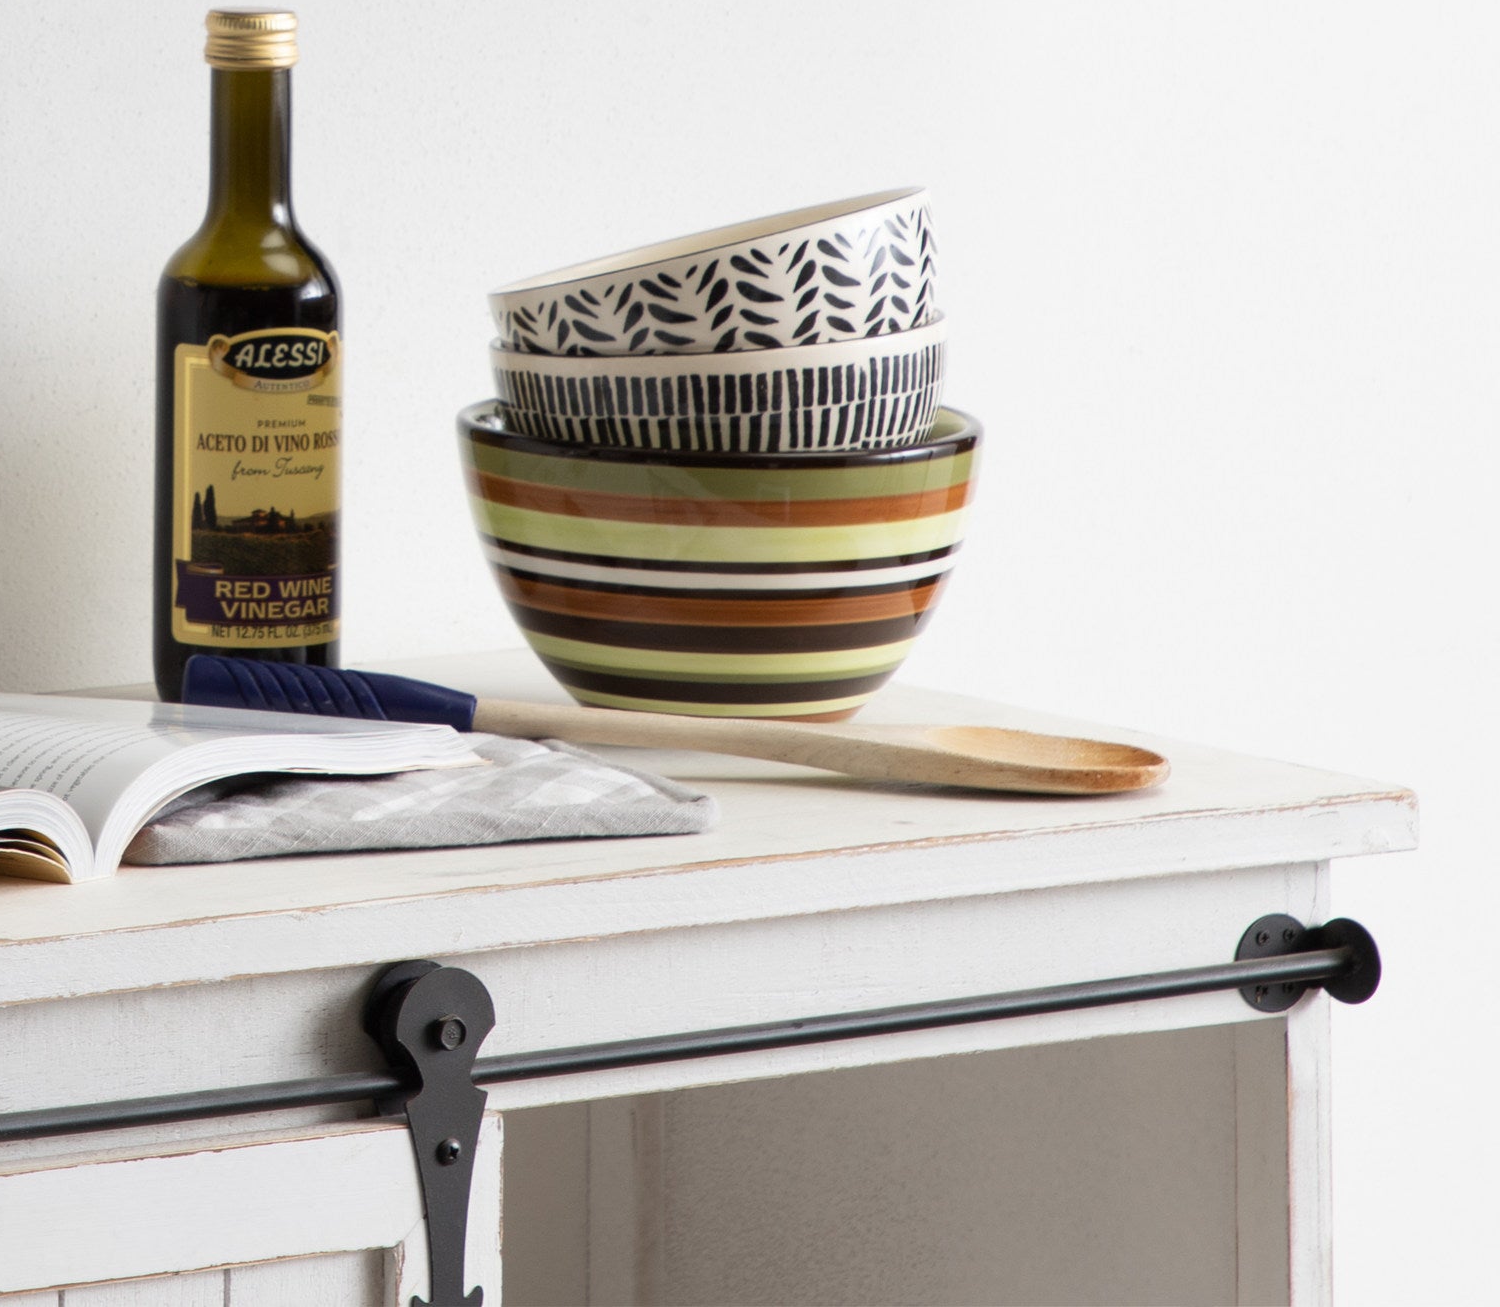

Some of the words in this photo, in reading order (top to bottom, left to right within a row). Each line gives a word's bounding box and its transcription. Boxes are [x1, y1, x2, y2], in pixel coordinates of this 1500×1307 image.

[234, 341, 324, 369] ALESSI
[253, 380, 311, 390] AUTENTICO
[257, 419, 307, 429] PREMIUM
[196, 432, 246, 453] ACETO
[251, 434, 269, 453] DI
[274, 433, 310, 453] VINO
[231, 459, 271, 481] from
[272, 456, 325, 480] Tuscany
[214, 580, 271, 599] RED
[278, 576, 333, 599] WINE
[220, 597, 330, 619] VINEGAR
[211, 624, 232, 638] NET
[235, 625, 266, 639] 12.75
